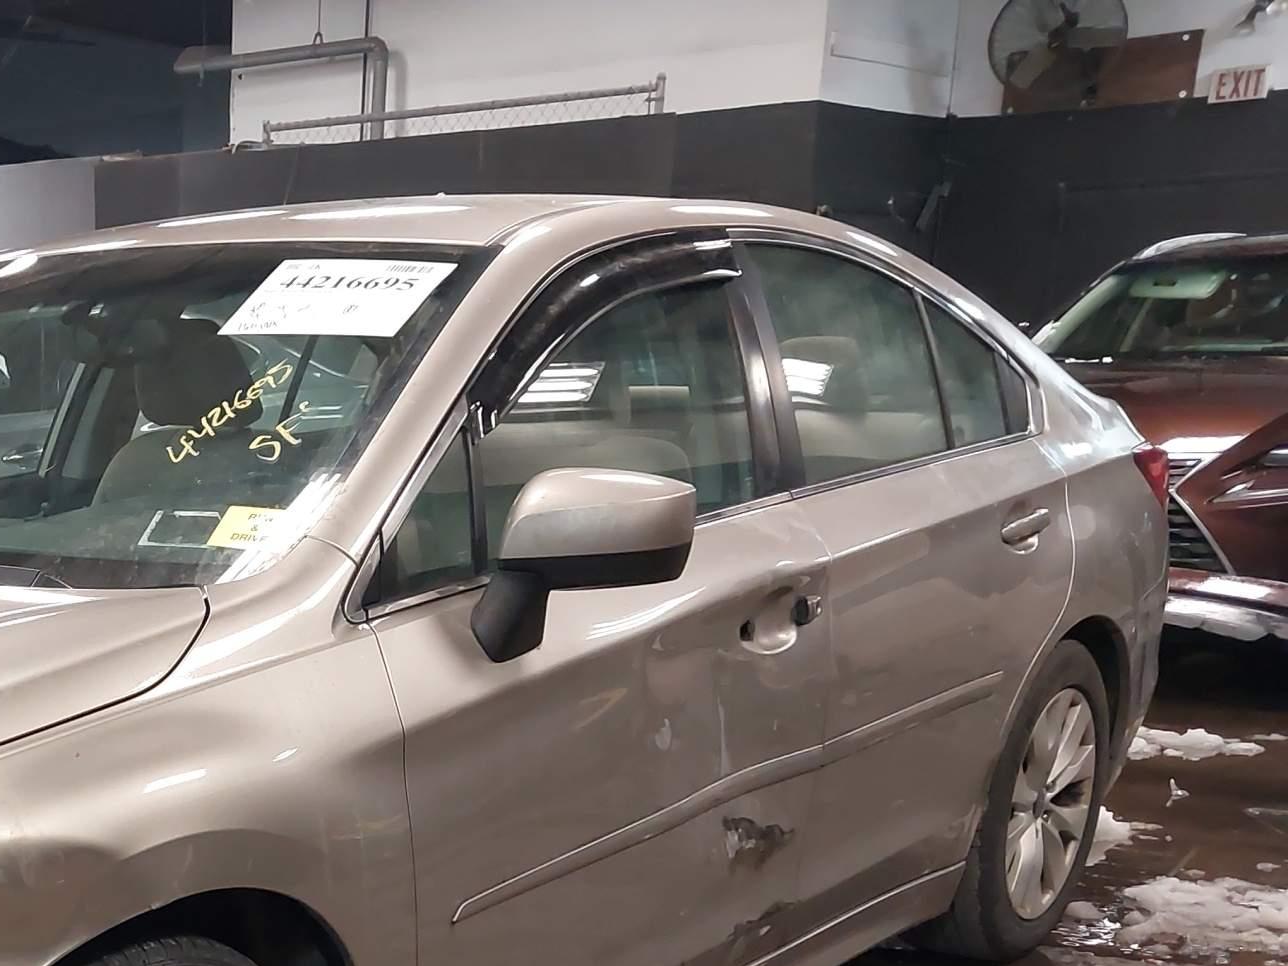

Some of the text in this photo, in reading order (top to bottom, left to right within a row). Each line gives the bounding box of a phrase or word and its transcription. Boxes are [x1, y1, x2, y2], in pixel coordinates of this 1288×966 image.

[1215, 67, 1265, 100] EXIT
[279, 275, 419, 291] 44216695
[166, 359, 293, 463] 44216695
